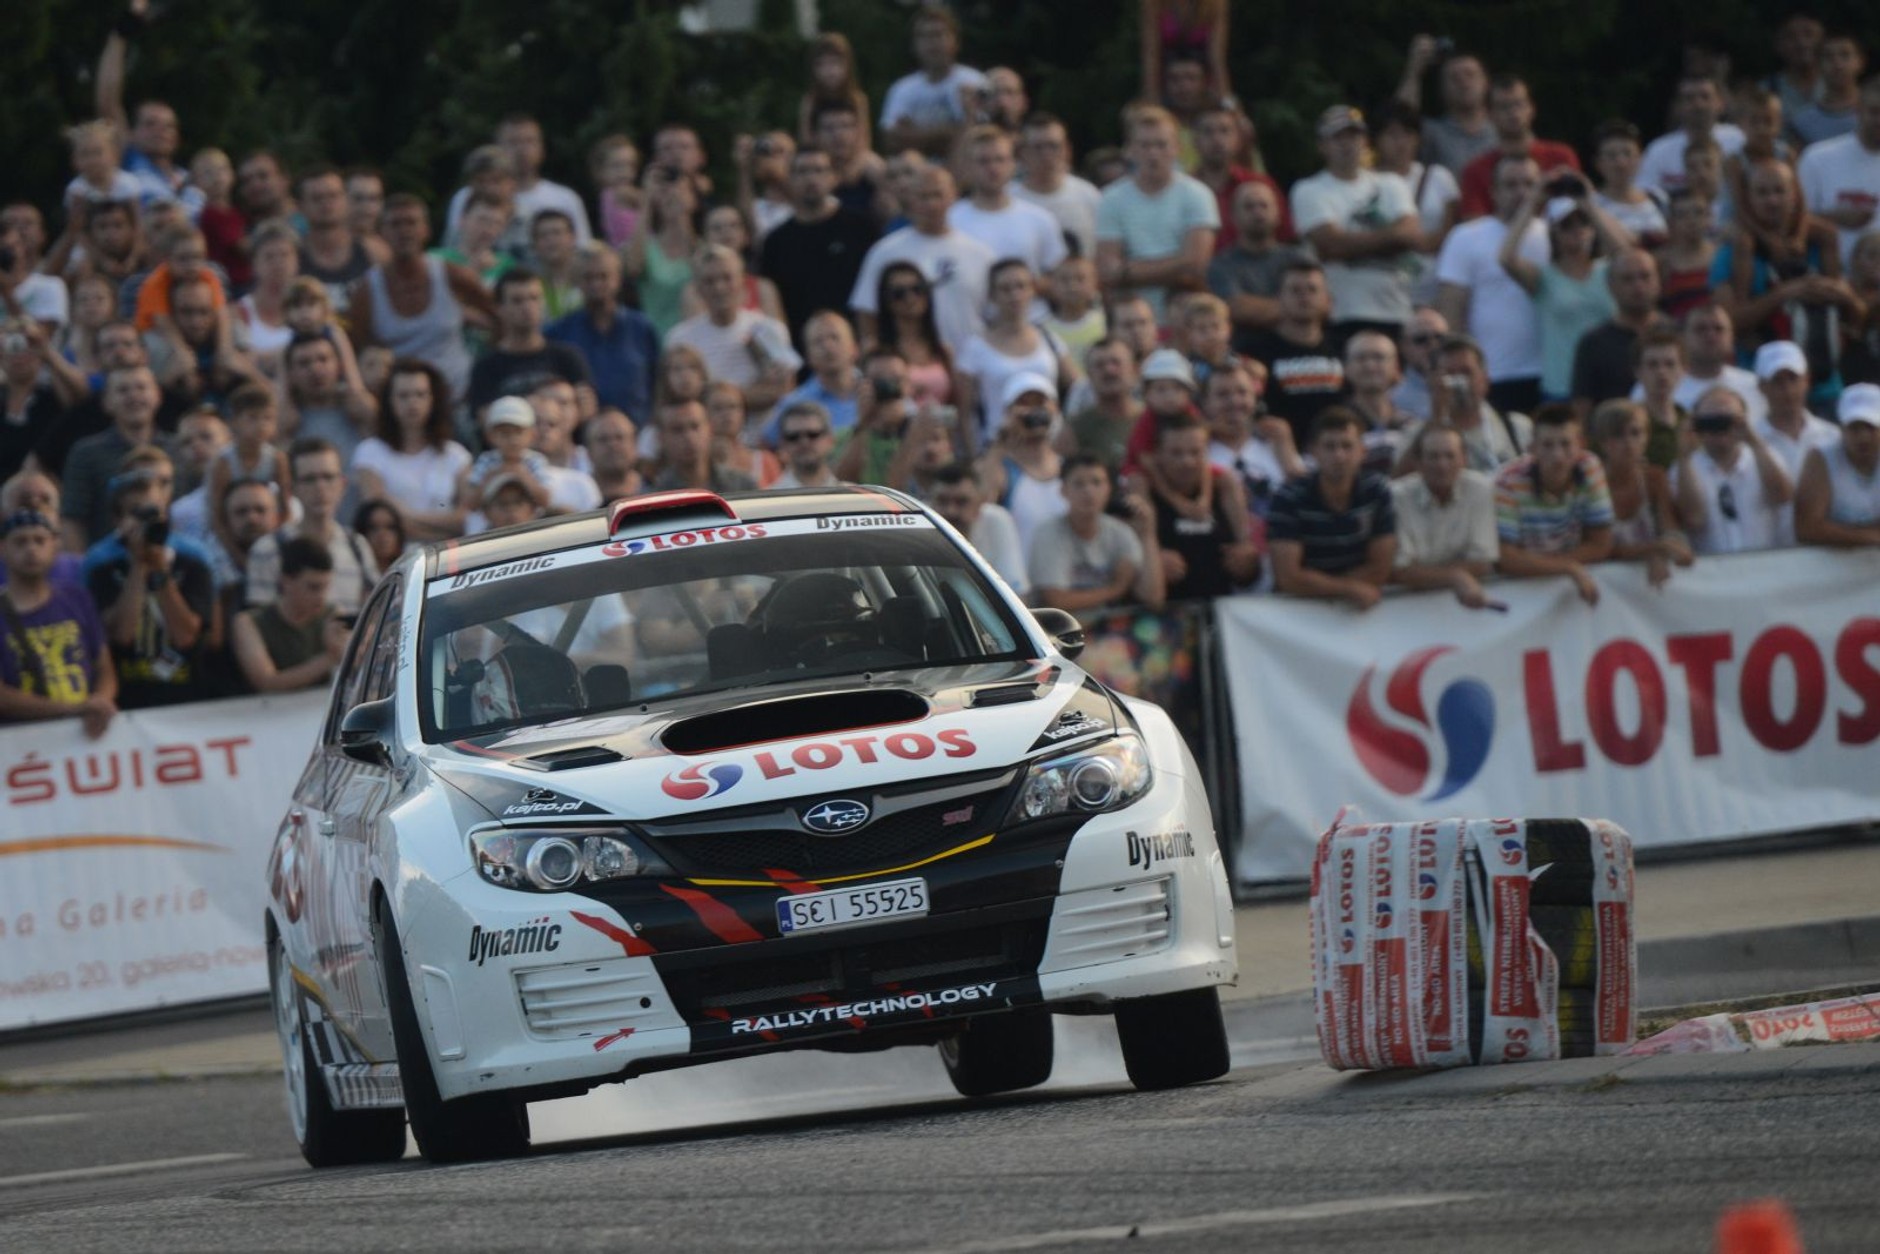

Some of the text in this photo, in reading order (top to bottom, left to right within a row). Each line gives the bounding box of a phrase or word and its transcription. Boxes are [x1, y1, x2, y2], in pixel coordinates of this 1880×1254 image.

[649, 525, 768, 550] LOTOS
[816, 513, 917, 531] Dynamic
[450, 557, 556, 590] Dynamic
[1522, 614, 1880, 774] LOTOS
[753, 728, 977, 780] LOTOS
[503, 801, 584, 816] kajto.pl
[1125, 829, 1195, 870] Dynamic
[849, 885, 924, 917] 55525
[1341, 848, 1354, 923] LOTOS
[469, 917, 562, 966] Dynamic
[731, 983, 998, 1034] RALLYTECHNOLOGY
